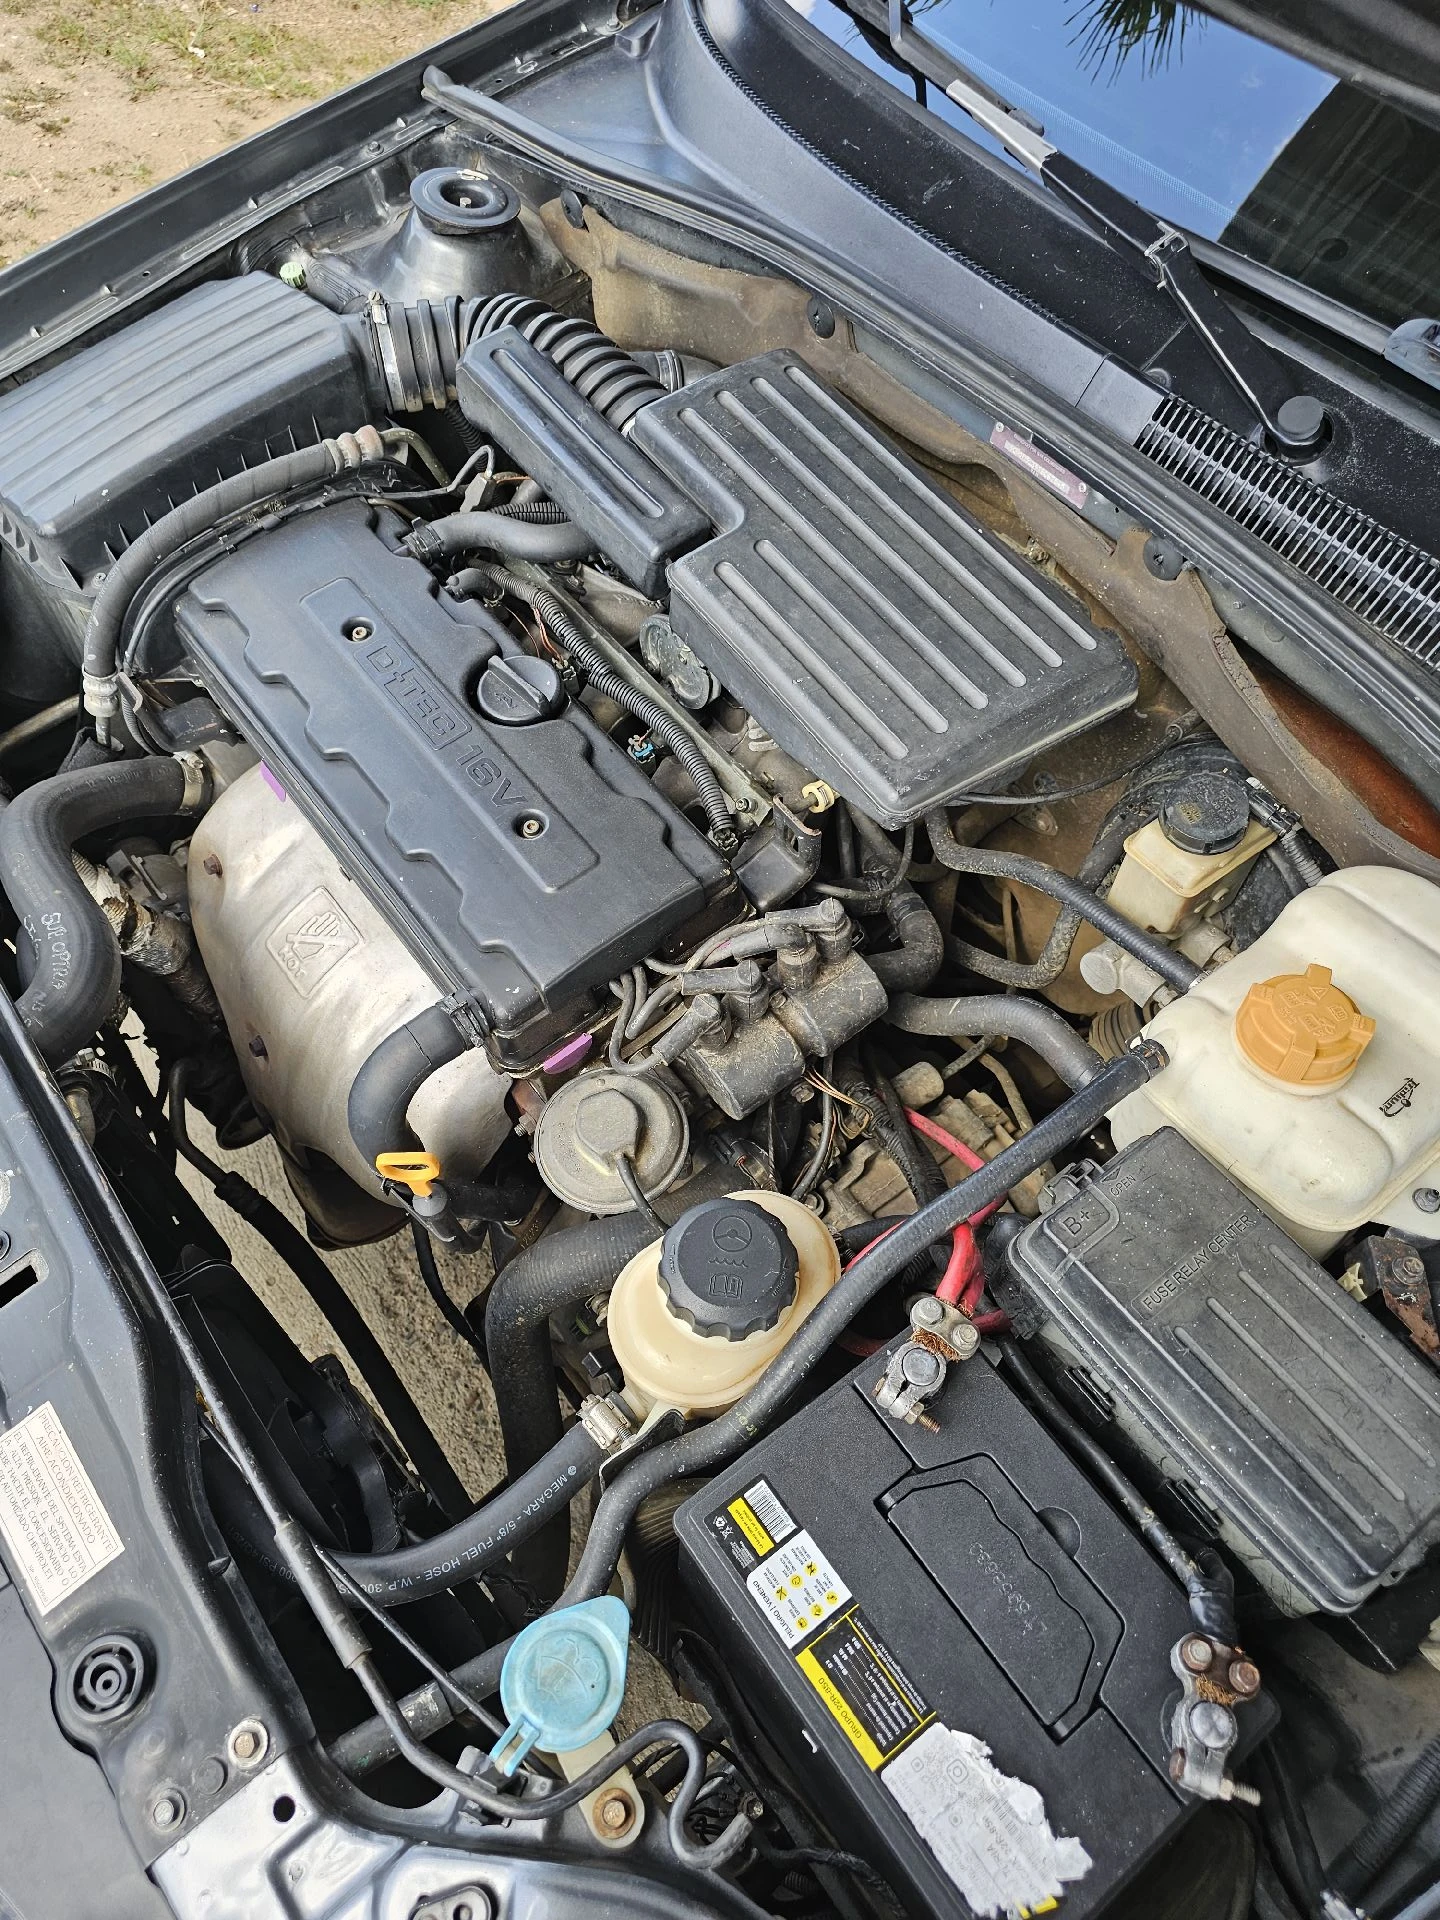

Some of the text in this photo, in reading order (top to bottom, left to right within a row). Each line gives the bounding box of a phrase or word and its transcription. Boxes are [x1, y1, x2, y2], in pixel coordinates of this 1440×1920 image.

[455, 743, 527, 808] 16V
[1108, 1172, 1136, 1198] OPEN
[1061, 1204, 1094, 1236] B+
[1142, 1212, 1253, 1310] FUSE RELAY CENTER
[35, 1434, 97, 1545] AIRE ACONDICIONADO
[37, 1412, 115, 1553] PRECAUCION REFRIGERANTE
[521, 1472, 568, 1518] MEGARA
[0, 1479, 31, 1532] AUTORIZADO
[8, 1448, 23, 1469] ALTA
[39, 1509, 51, 1523] EL
[46, 1524, 71, 1563] SERVICIO
[67, 1565, 78, 1579] LO
[13, 1431, 88, 1572] EL REFRIGERANTE DEL SISTEMA ESTA
[6, 1467, 25, 1497] HACER
[20, 1496, 31, 1510] EL
[27, 1509, 65, 1577] CONCESIONARIO
[491, 1518, 517, 1541] 5/8"
[460, 1535, 495, 1562] FUEL
[385, 1576, 412, 1590] W.P.
[421, 1555, 461, 1581] HOSE
[751, 1579, 774, 1607] VENENO
[771, 1608, 795, 1639] PELIGRO
[816, 1676, 844, 1711] 22R-850
[839, 1708, 863, 1739] GRUPO
